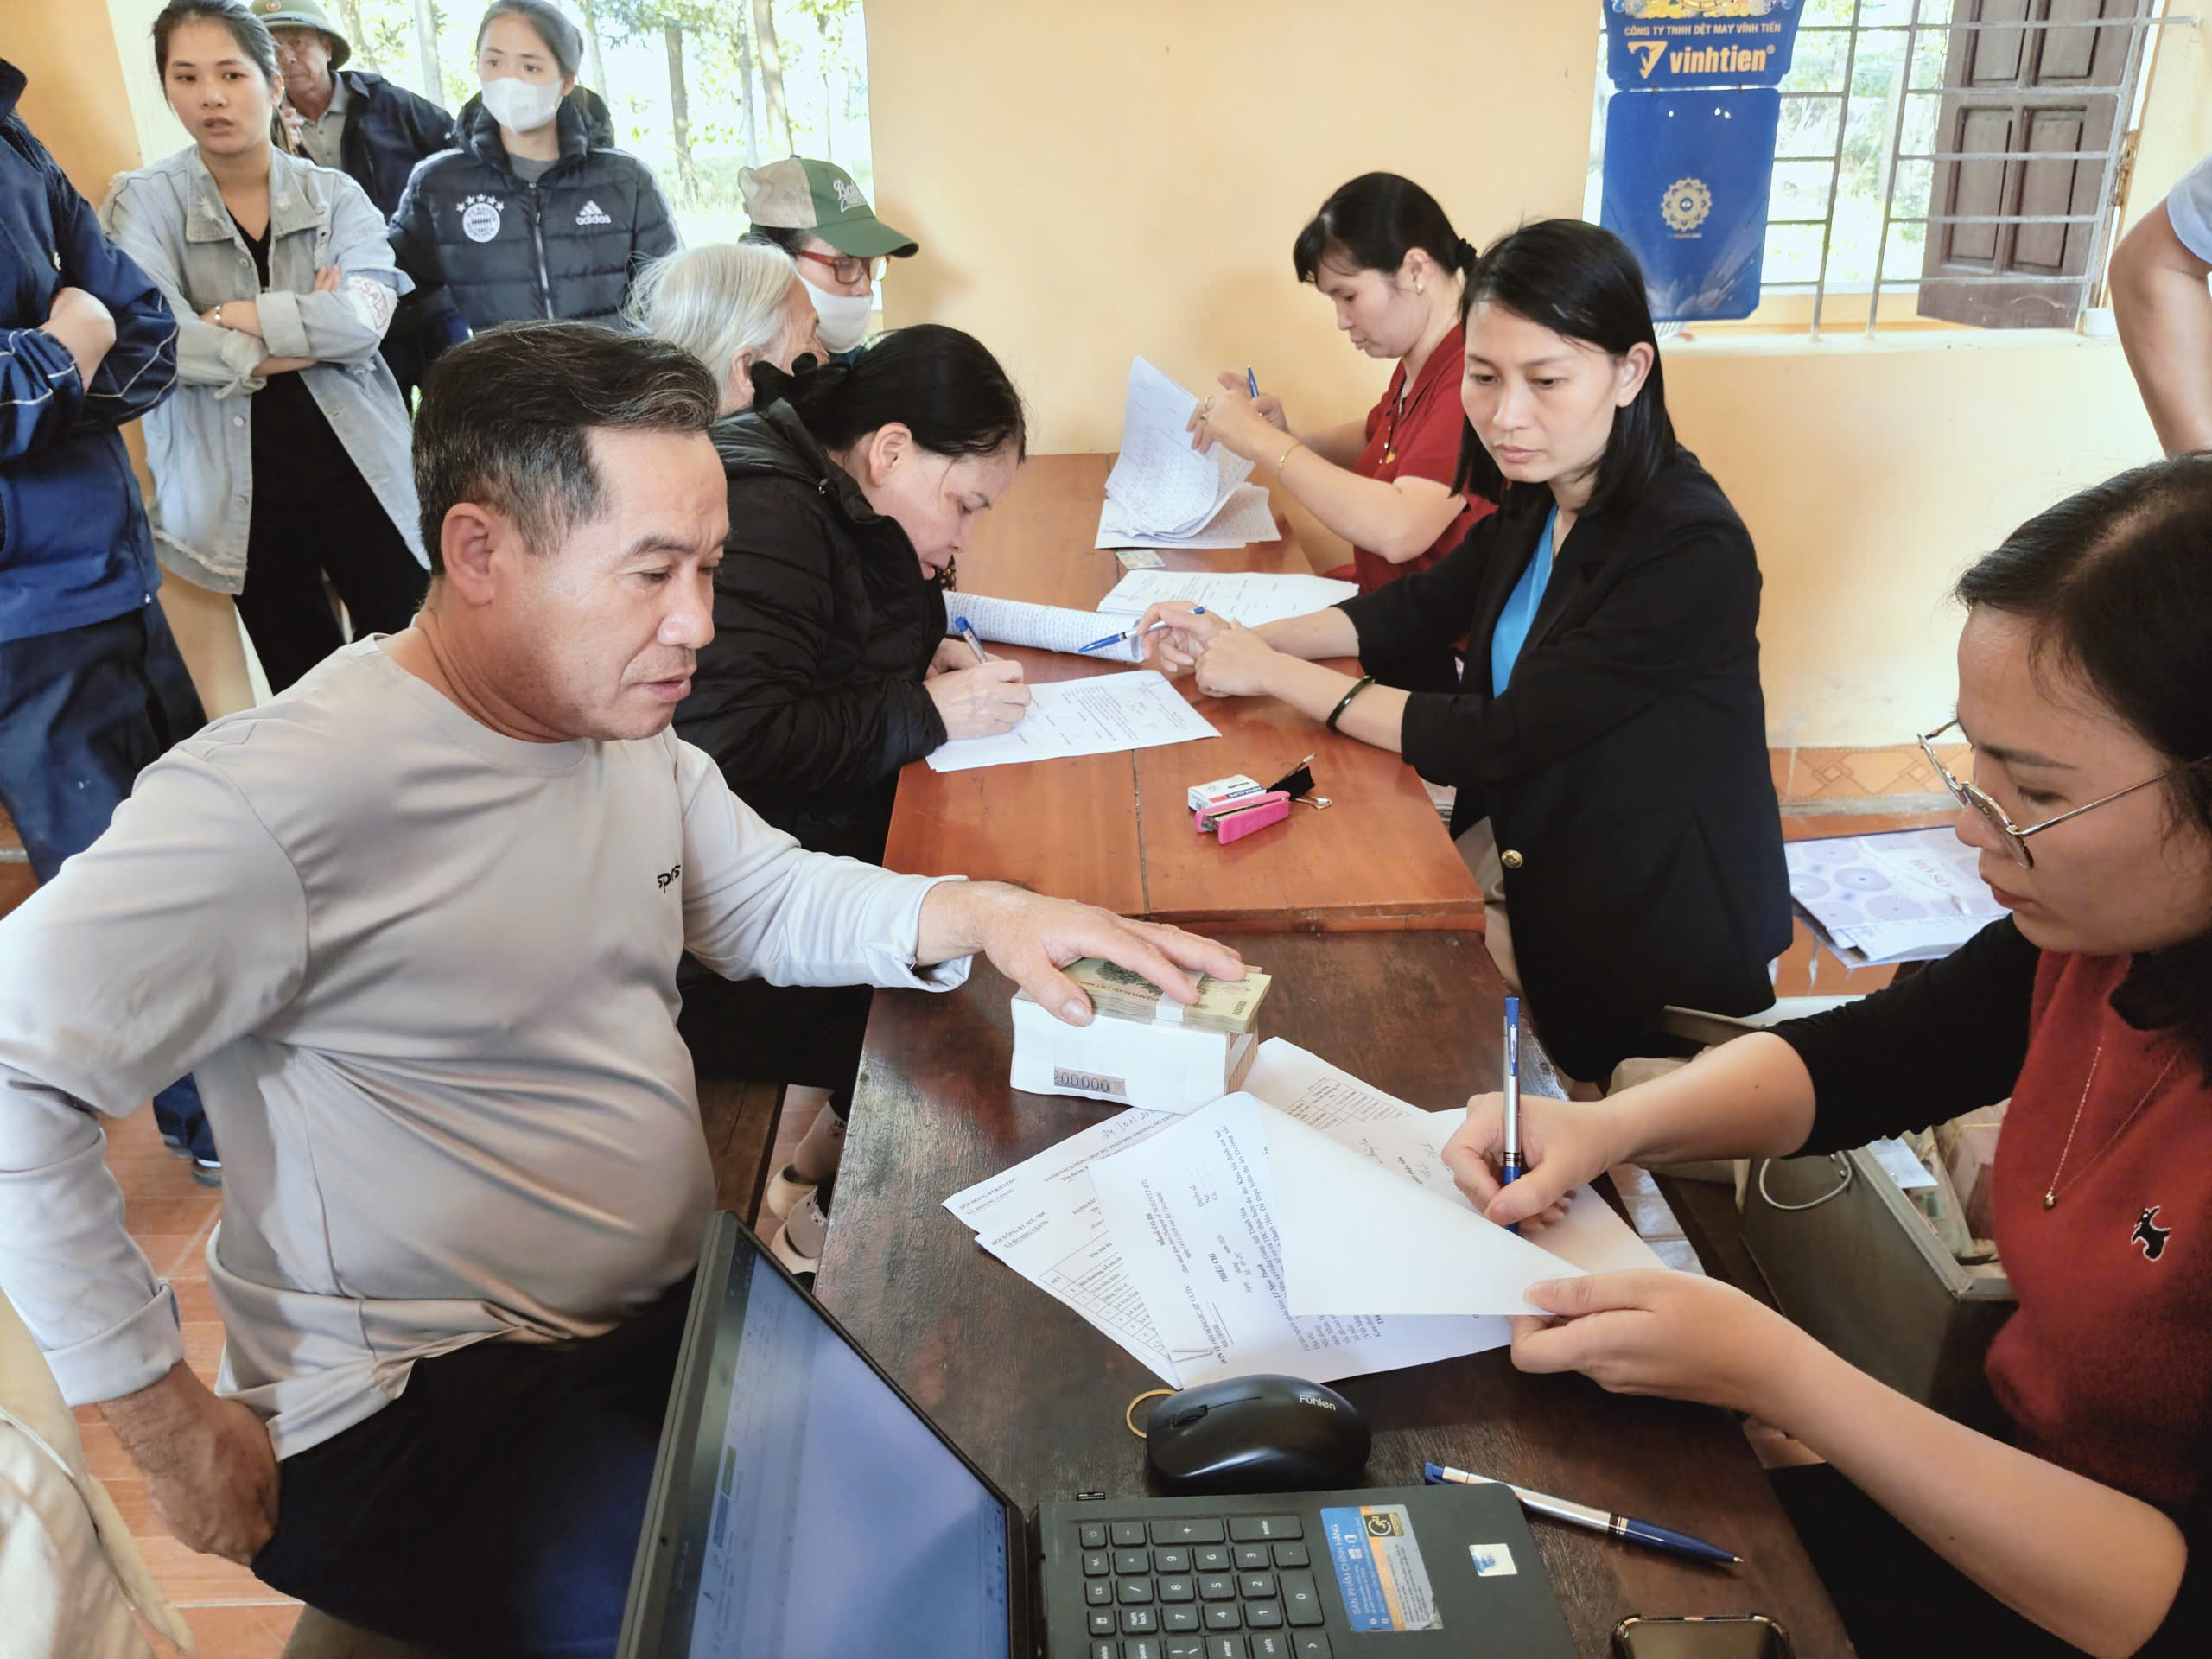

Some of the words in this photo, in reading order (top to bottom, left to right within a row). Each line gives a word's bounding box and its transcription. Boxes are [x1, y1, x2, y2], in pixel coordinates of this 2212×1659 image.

[1624, 24, 1649, 36] CÔNG
[1653, 26, 1665, 35] TY
[1667, 25, 1691, 35] TNHH
[1694, 24, 1711, 36] DỆT
[1713, 23, 1734, 34] MAY
[1737, 22, 1758, 34] VĨNH
[575, 214, 612, 226] adidas
[1232, 1170, 1244, 1185] Khu
[1207, 1251, 1219, 1266] CHI
[1211, 1262, 1230, 1285] PHIẾU
[1255, 1262, 1269, 1280] Thanh
[1327, 1522, 1343, 1547] HÀNG
